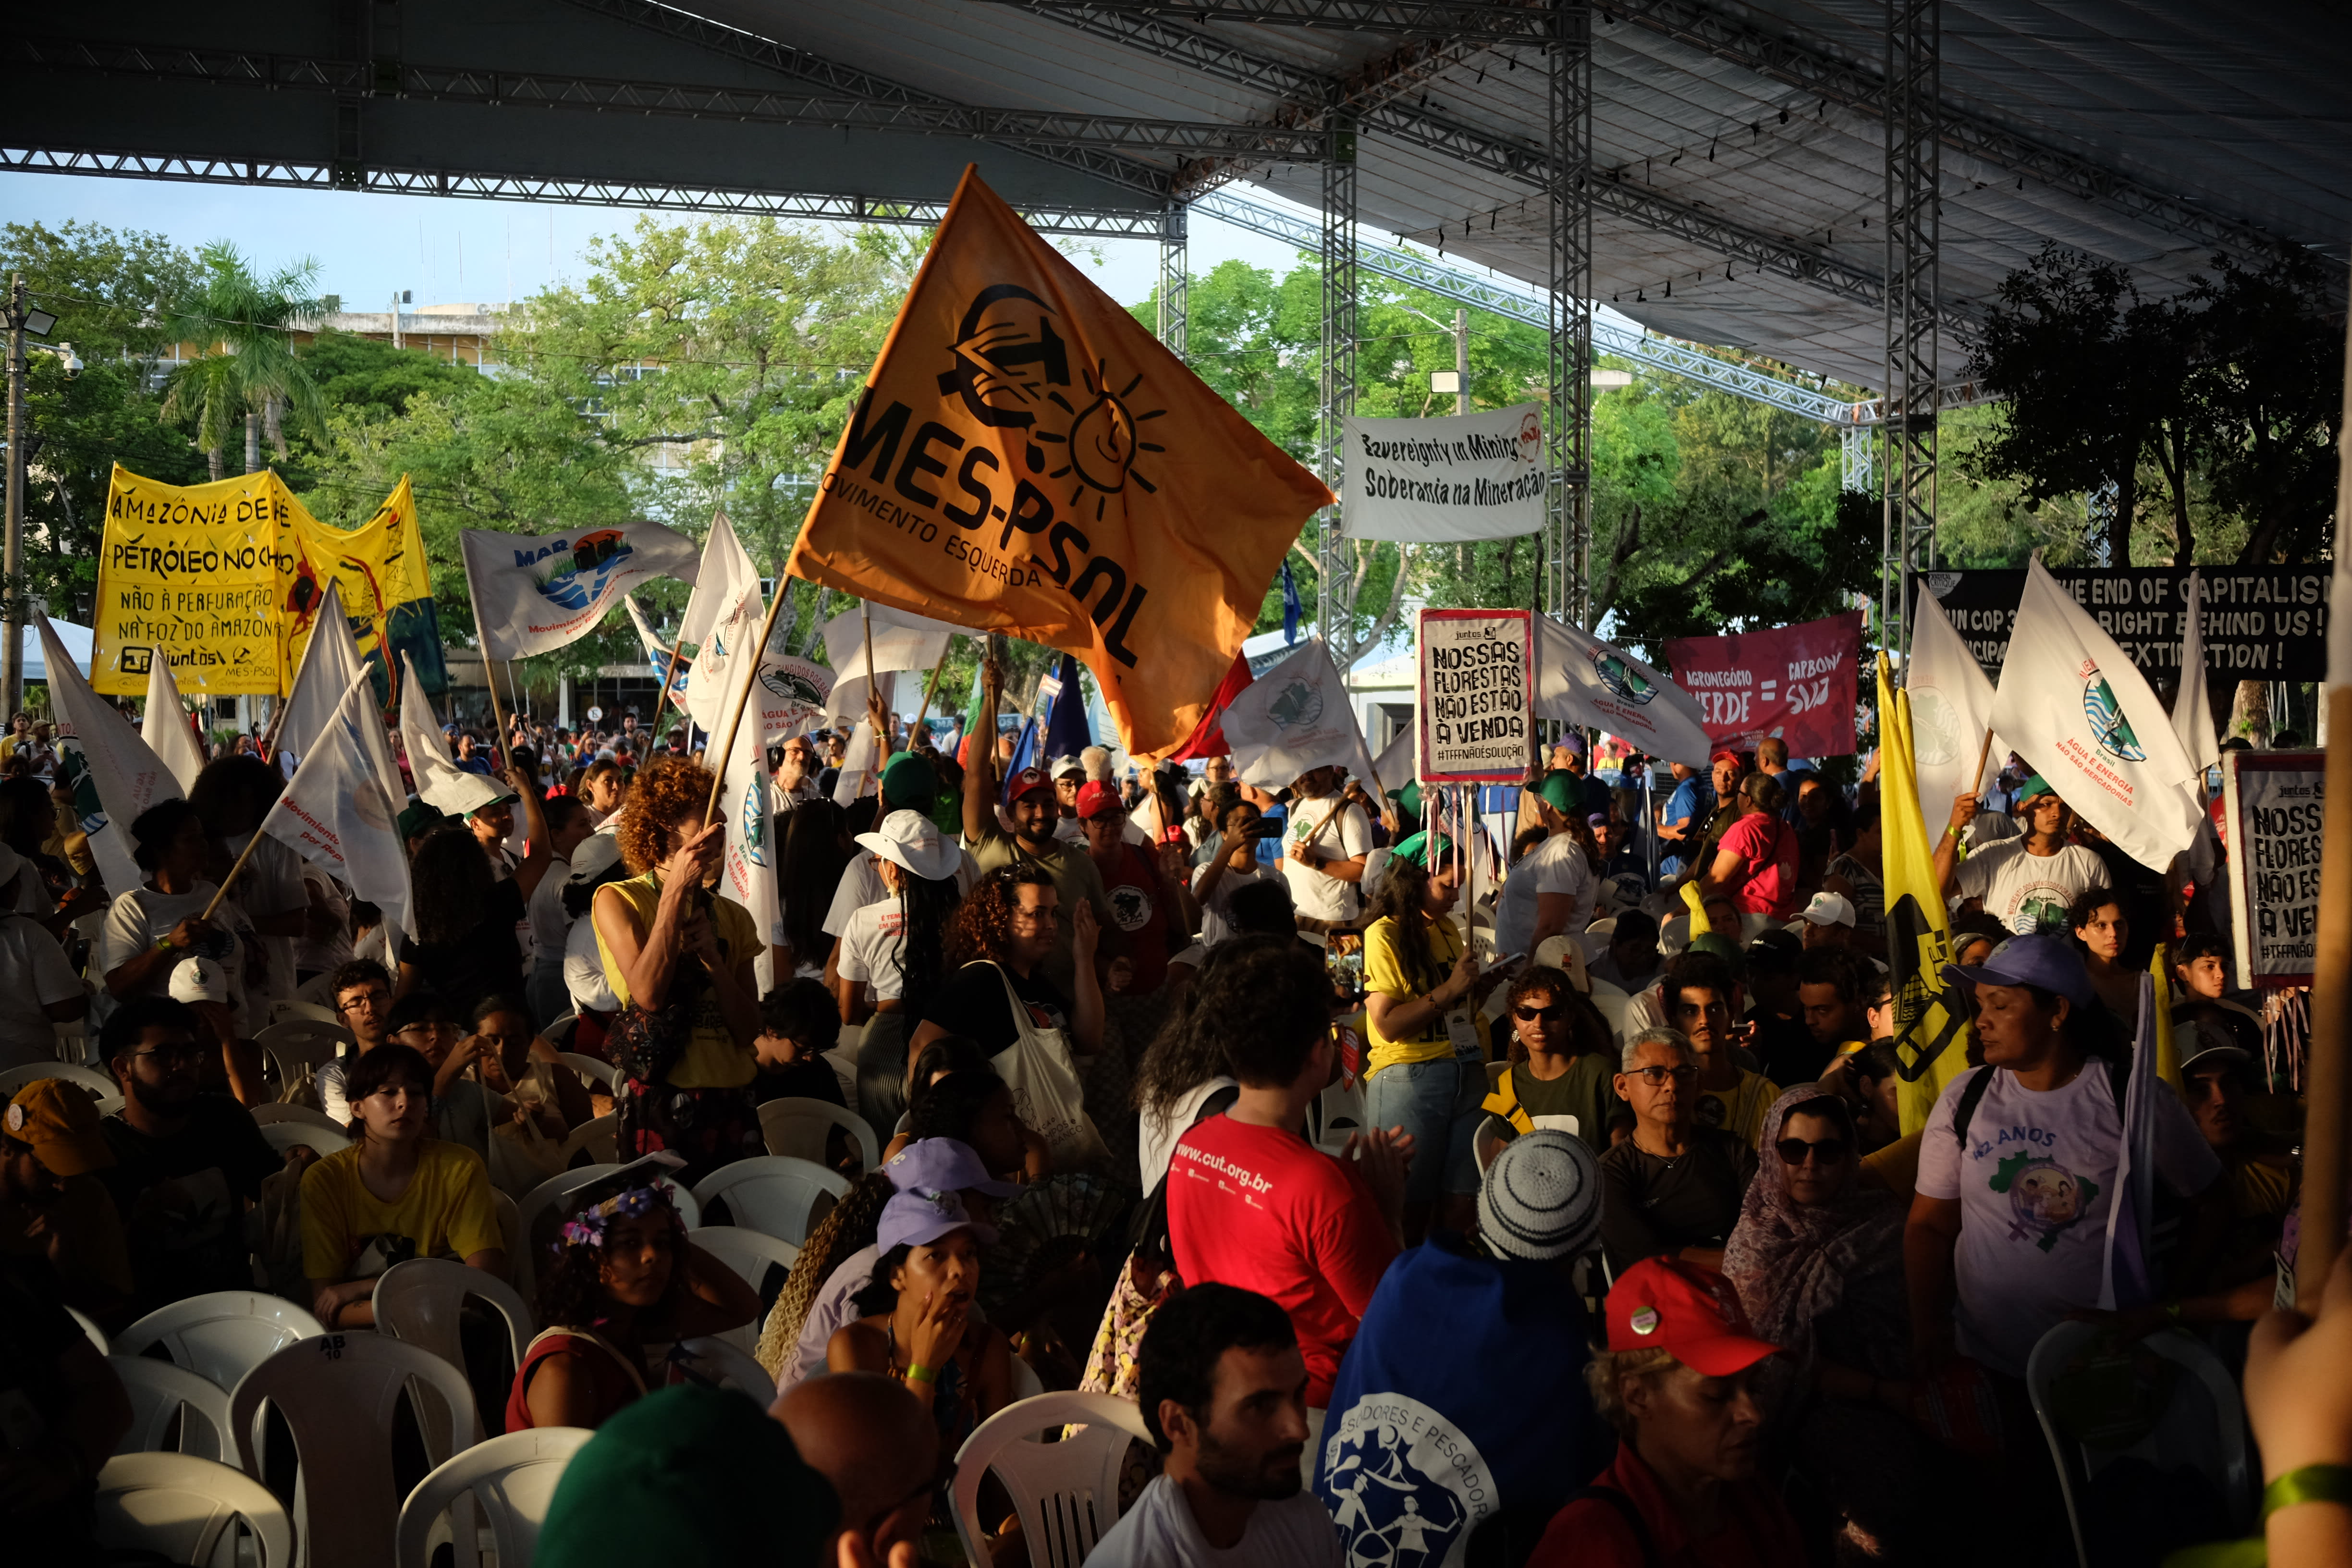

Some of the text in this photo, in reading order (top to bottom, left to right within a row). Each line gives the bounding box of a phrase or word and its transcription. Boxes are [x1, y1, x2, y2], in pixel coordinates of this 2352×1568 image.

[1452, 441, 1470, 462] in
[1467, 433, 1519, 462] Mining
[1365, 466, 1545, 507] Soberania na Mineração
[237, 498, 268, 523] DE
[822, 472, 1042, 589] OVIMENTO ESQUERDA
[223, 547, 255, 571] NO
[514, 539, 569, 568] MAR
[121, 584, 273, 613] NÃO À PERFURAÇÃO
[2092, 578, 2133, 605] END
[2139, 577, 2169, 604] OF
[119, 622, 139, 640] NA
[147, 624, 177, 641] FOZ
[184, 622, 203, 641] DO
[528, 610, 591, 634] Movimiento
[565, 622, 583, 635] por
[1971, 609, 2004, 633] COP
[2007, 609, 2018, 633] 3
[2098, 611, 2169, 636] RIGHT
[1454, 631, 1482, 640] juntos
[1433, 641, 1519, 670] NOSSAS
[226, 666, 277, 677] MES-PSOL
[809, 671, 822, 685] POR
[1434, 665, 1521, 694] FLORESTAS
[1686, 667, 1752, 687] AGRONEGÓCIO
[1435, 687, 1521, 719] NÃO ESTÃO
[1617, 698, 1635, 709] Brasil
[1622, 708, 1652, 726] ENERGIA
[1436, 716, 1523, 745] À VENDA
[2067, 737, 2134, 795] ÁGUA E ENERGIA
[2095, 748, 2115, 768] Brasil
[2055, 741, 2133, 807] NÃO SÃO MERCADORIAS
[2278, 785, 2310, 797] juntos
[281, 796, 339, 845] Movimiento
[2252, 803, 2322, 837] NOSS
[300, 831, 321, 845] por
[2254, 835, 2322, 870] FLORES
[2256, 870, 2295, 904] NÃO
[2008, 888, 2024, 915] MOVIMENTO
[2258, 902, 2277, 938] À
[1044, 1120, 1069, 1140] MPOS
[1051, 1125, 1084, 1146] RANCO
[1998, 1126, 2057, 1147] ANOS
[320, 1335, 345, 1351] AB
[1412, 1416, 1425, 1433] E
